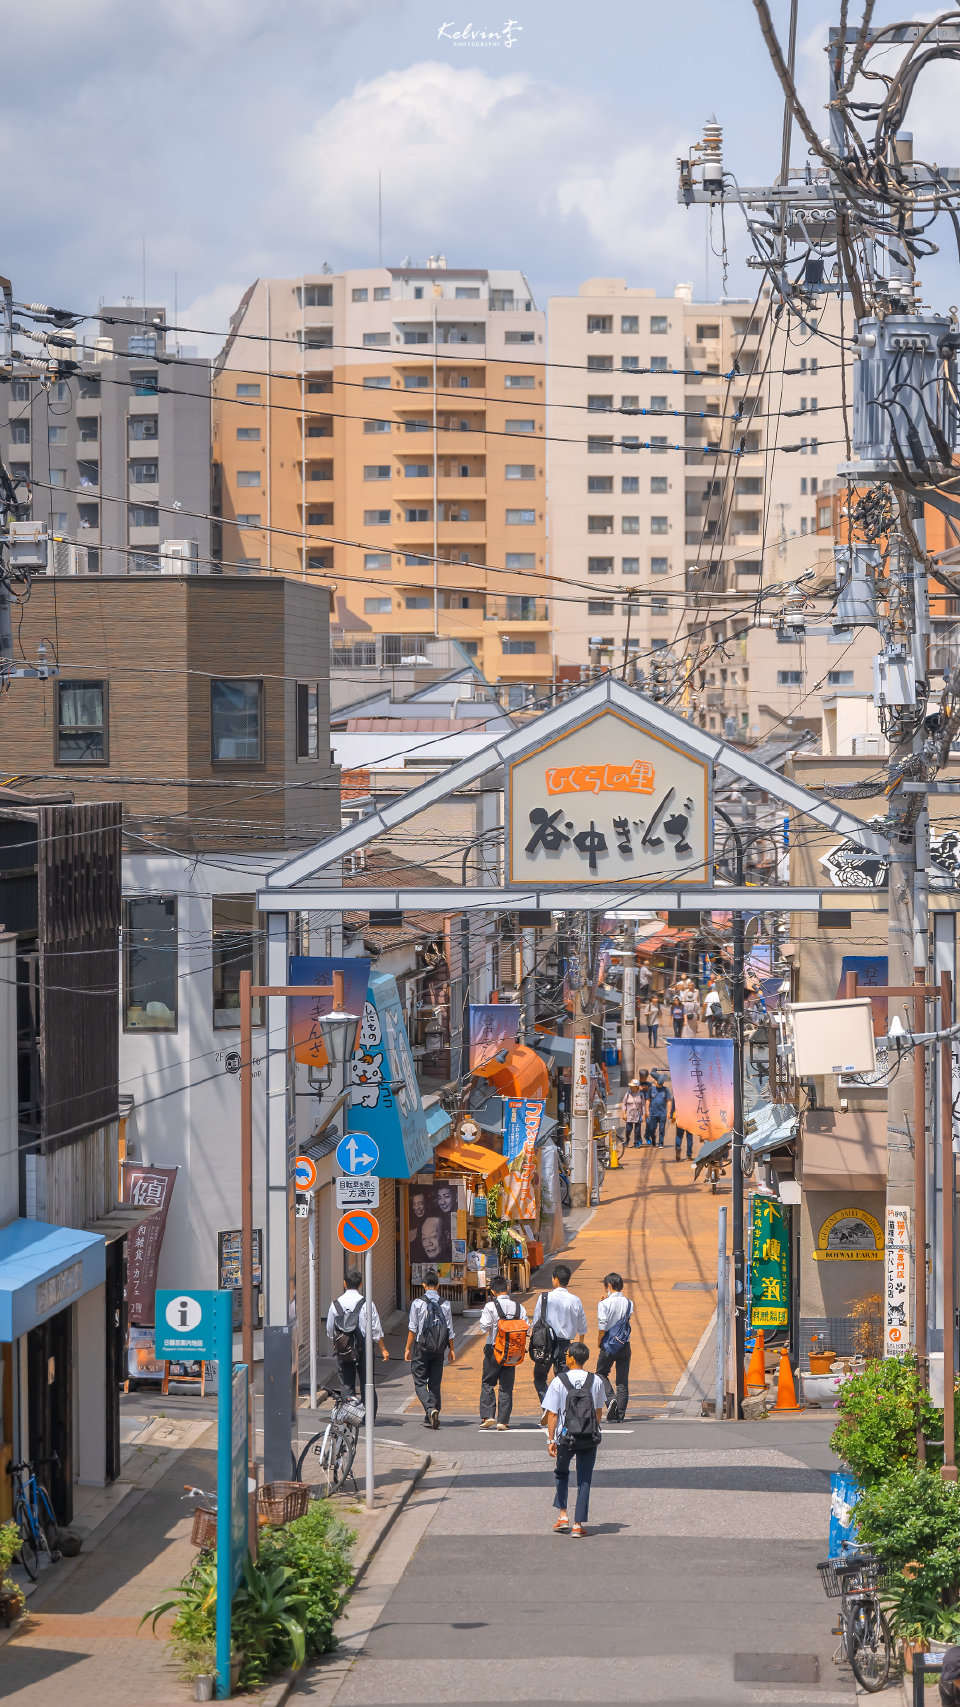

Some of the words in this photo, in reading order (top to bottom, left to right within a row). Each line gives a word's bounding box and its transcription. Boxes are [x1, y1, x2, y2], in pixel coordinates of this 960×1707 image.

[546, 760, 655, 795] ひぐらしの里
[525, 786, 693, 868] 谷中ぎんざ
[339, 1180, 376, 1190] 自転車を除く
[339, 1189, 376, 1198] 一方通行
